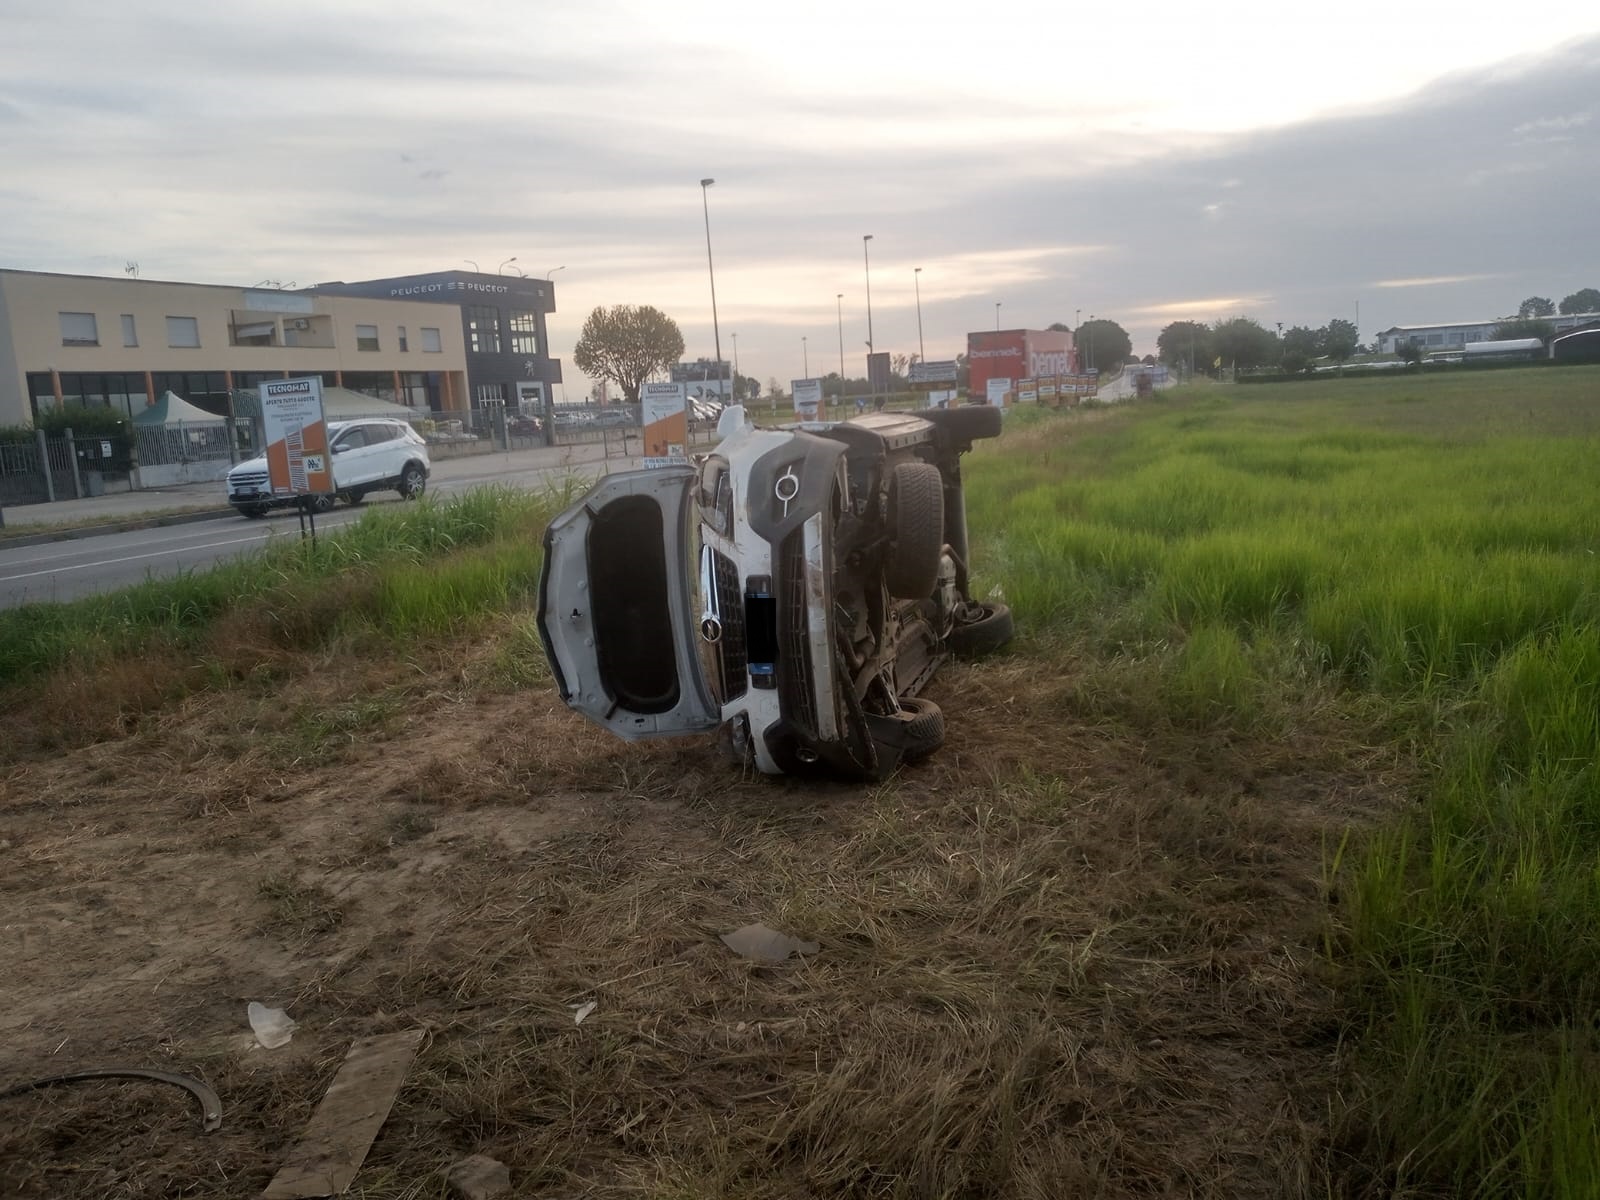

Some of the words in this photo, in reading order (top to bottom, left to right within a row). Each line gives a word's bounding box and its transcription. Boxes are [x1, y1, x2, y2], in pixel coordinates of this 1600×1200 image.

[391, 283, 443, 296] PEUGEOT
[468, 282, 508, 293] PEUGEOT
[1030, 344, 1071, 376] bennet
[268, 383, 309, 395] TECNOMAT
